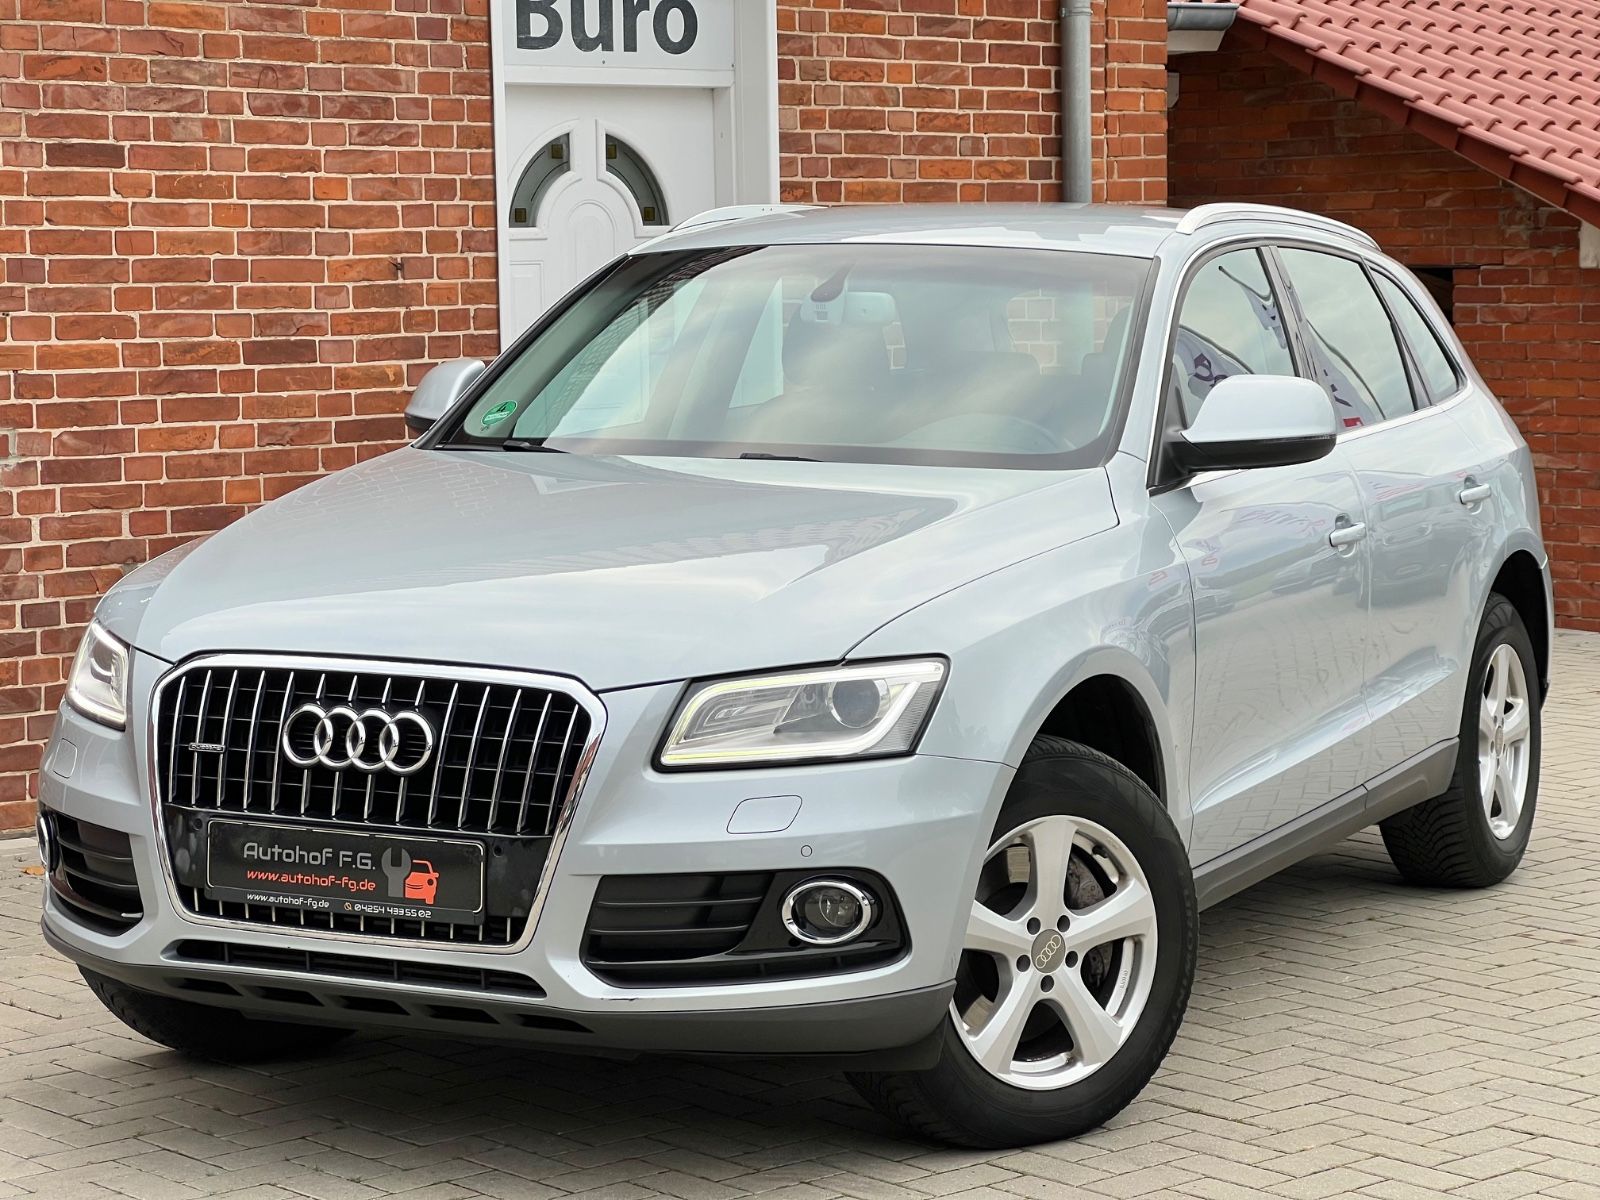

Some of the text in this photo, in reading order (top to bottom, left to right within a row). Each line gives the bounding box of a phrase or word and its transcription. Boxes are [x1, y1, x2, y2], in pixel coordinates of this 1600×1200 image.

[243, 842, 376, 870] Autohof F.G.
[246, 870, 376, 892] www.autohof-fg.de
[246, 893, 330, 909] www.autohof-fg.de
[354, 903, 385, 914] 04254
